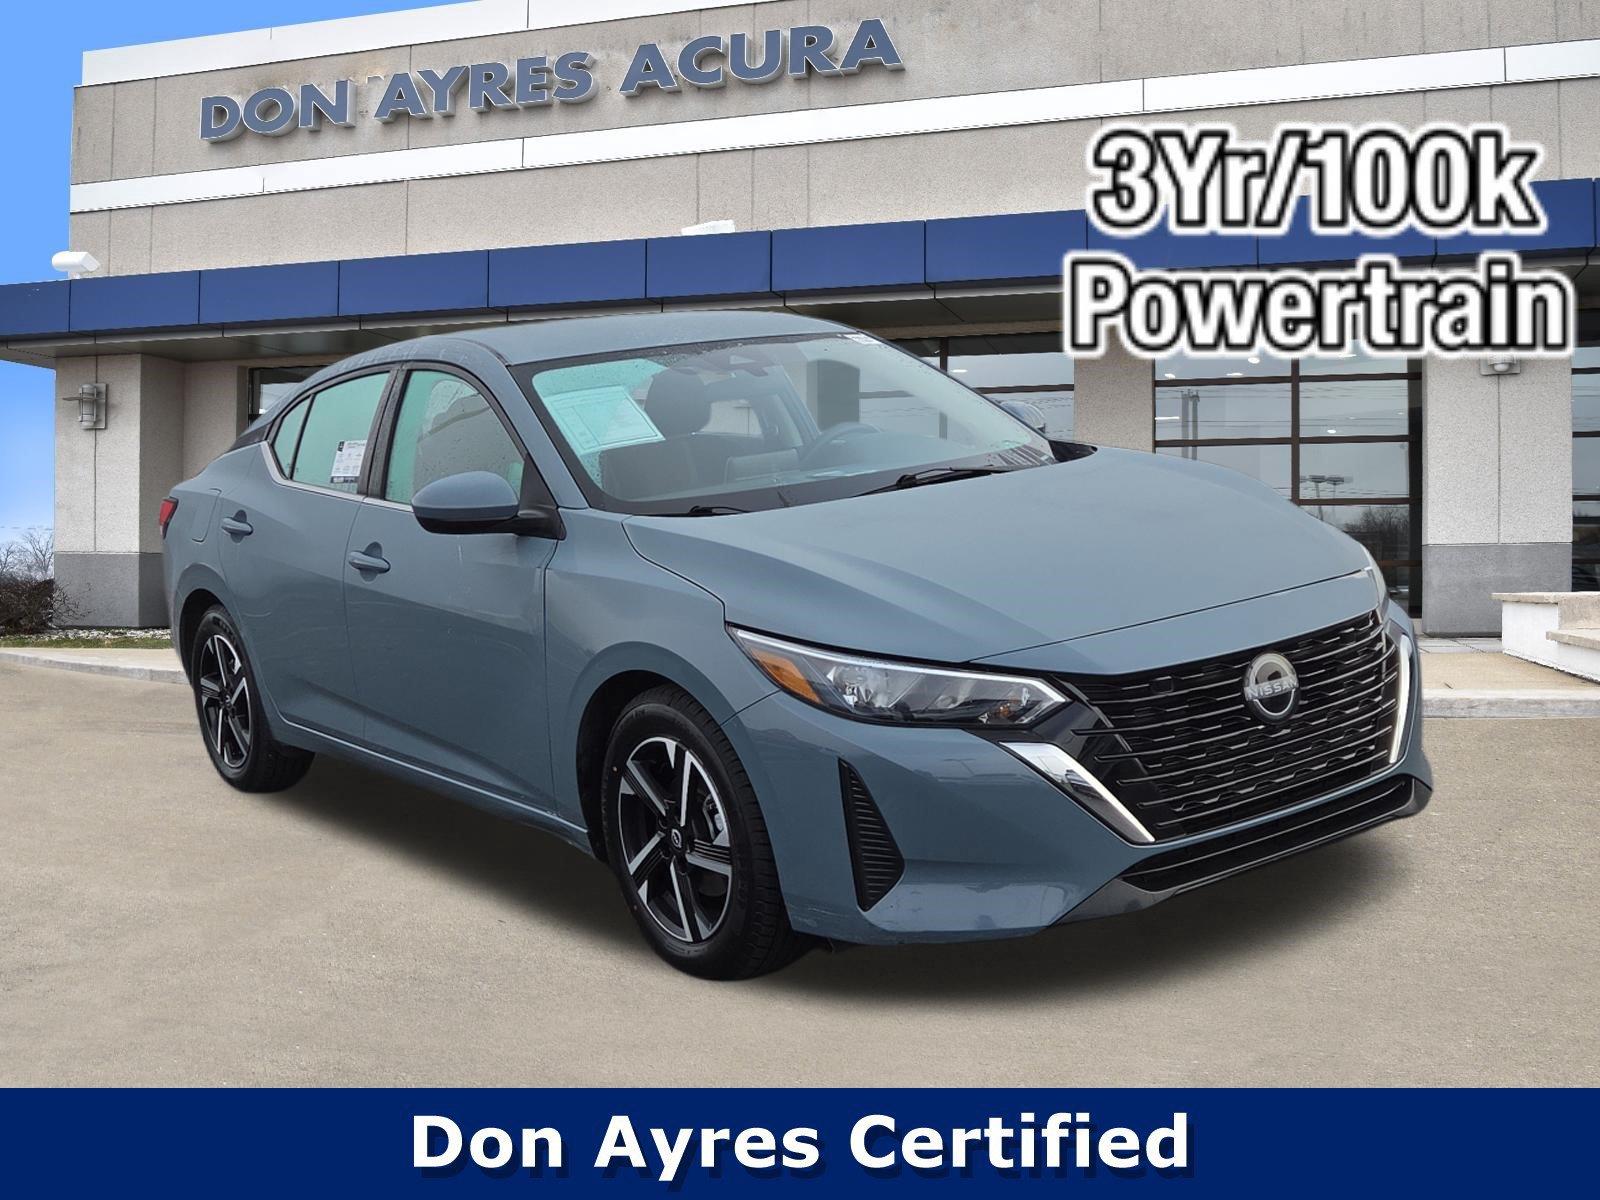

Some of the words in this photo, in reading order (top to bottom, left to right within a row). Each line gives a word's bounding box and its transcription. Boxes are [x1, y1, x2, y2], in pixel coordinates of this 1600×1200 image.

[199, 79, 355, 142] DON
[374, 51, 596, 122] AYRES
[619, 18, 905, 96] ACURA
[1247, 678, 1297, 699] NISSAN
